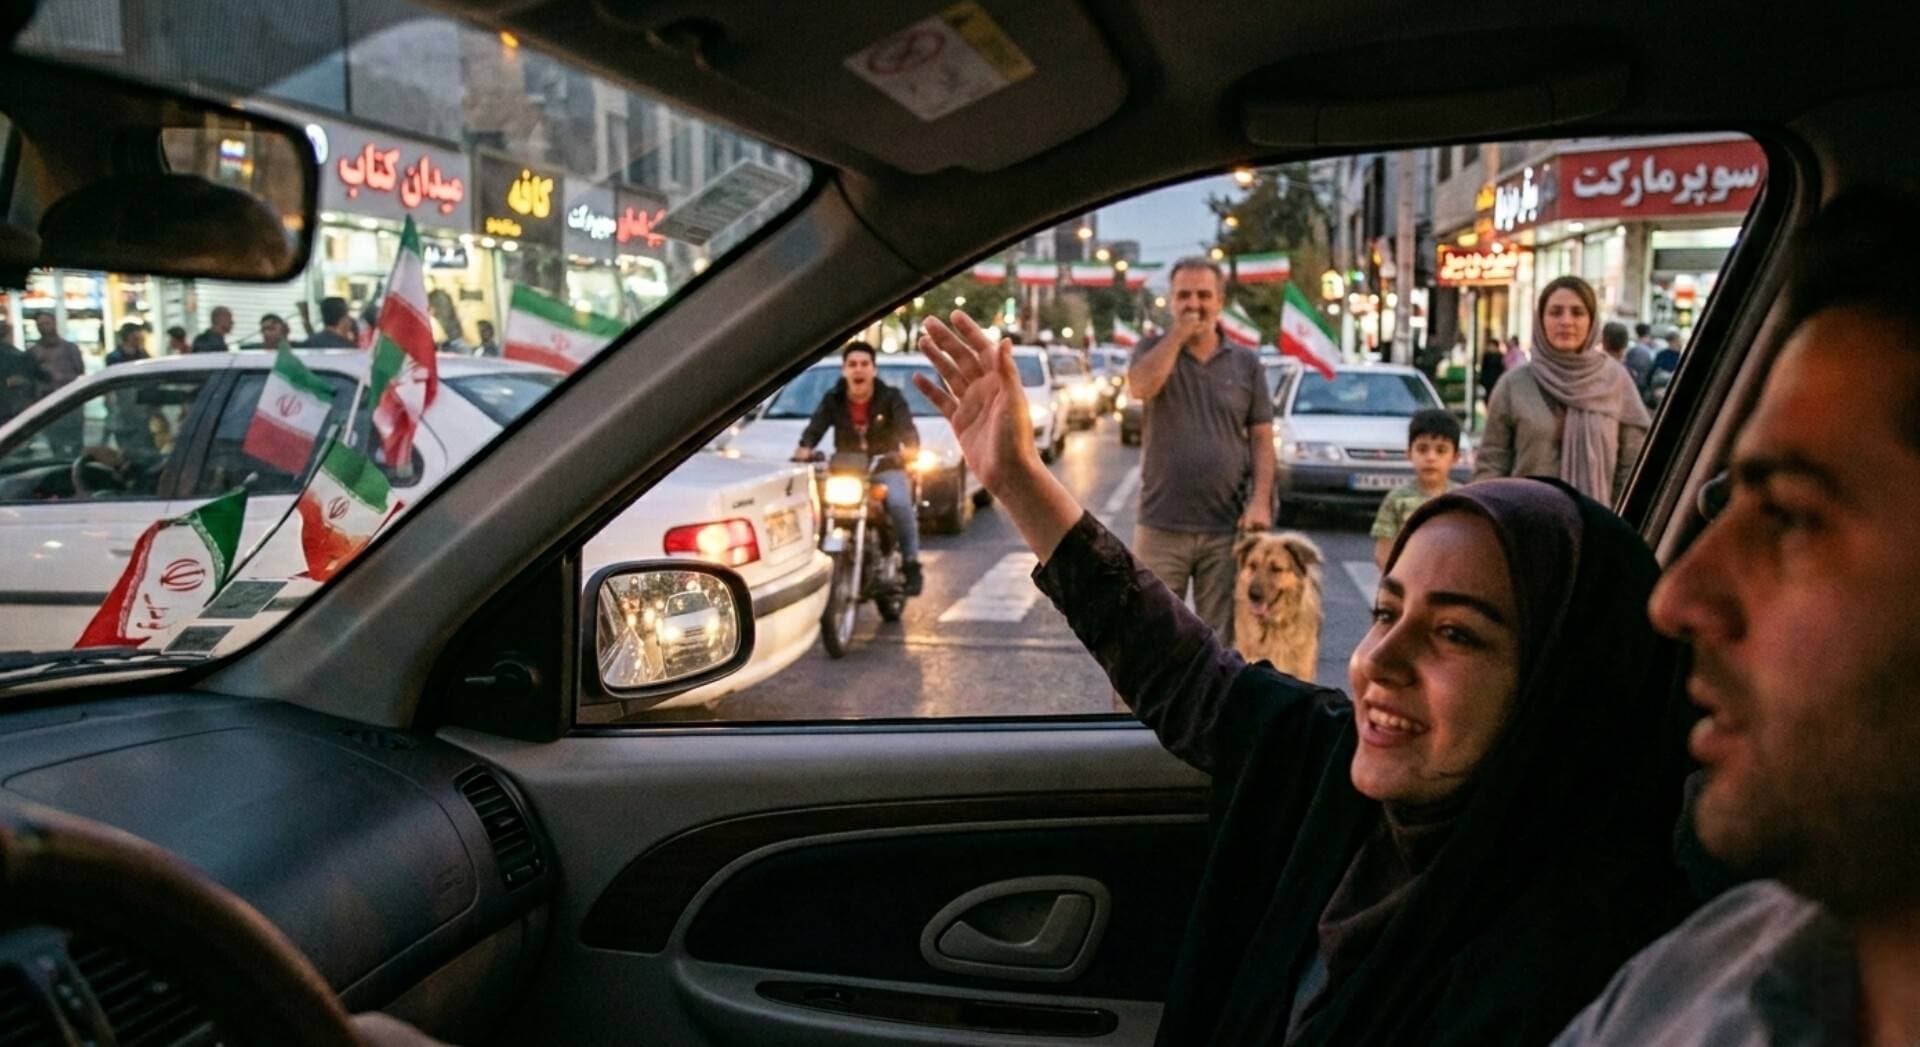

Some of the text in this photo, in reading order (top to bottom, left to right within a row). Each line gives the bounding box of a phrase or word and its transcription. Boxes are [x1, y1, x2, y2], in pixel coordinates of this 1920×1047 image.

[338, 142, 465, 214] میدان کتاب
[508, 168, 553, 218] کافه
[1573, 155, 1759, 206] سوپرمارکت
